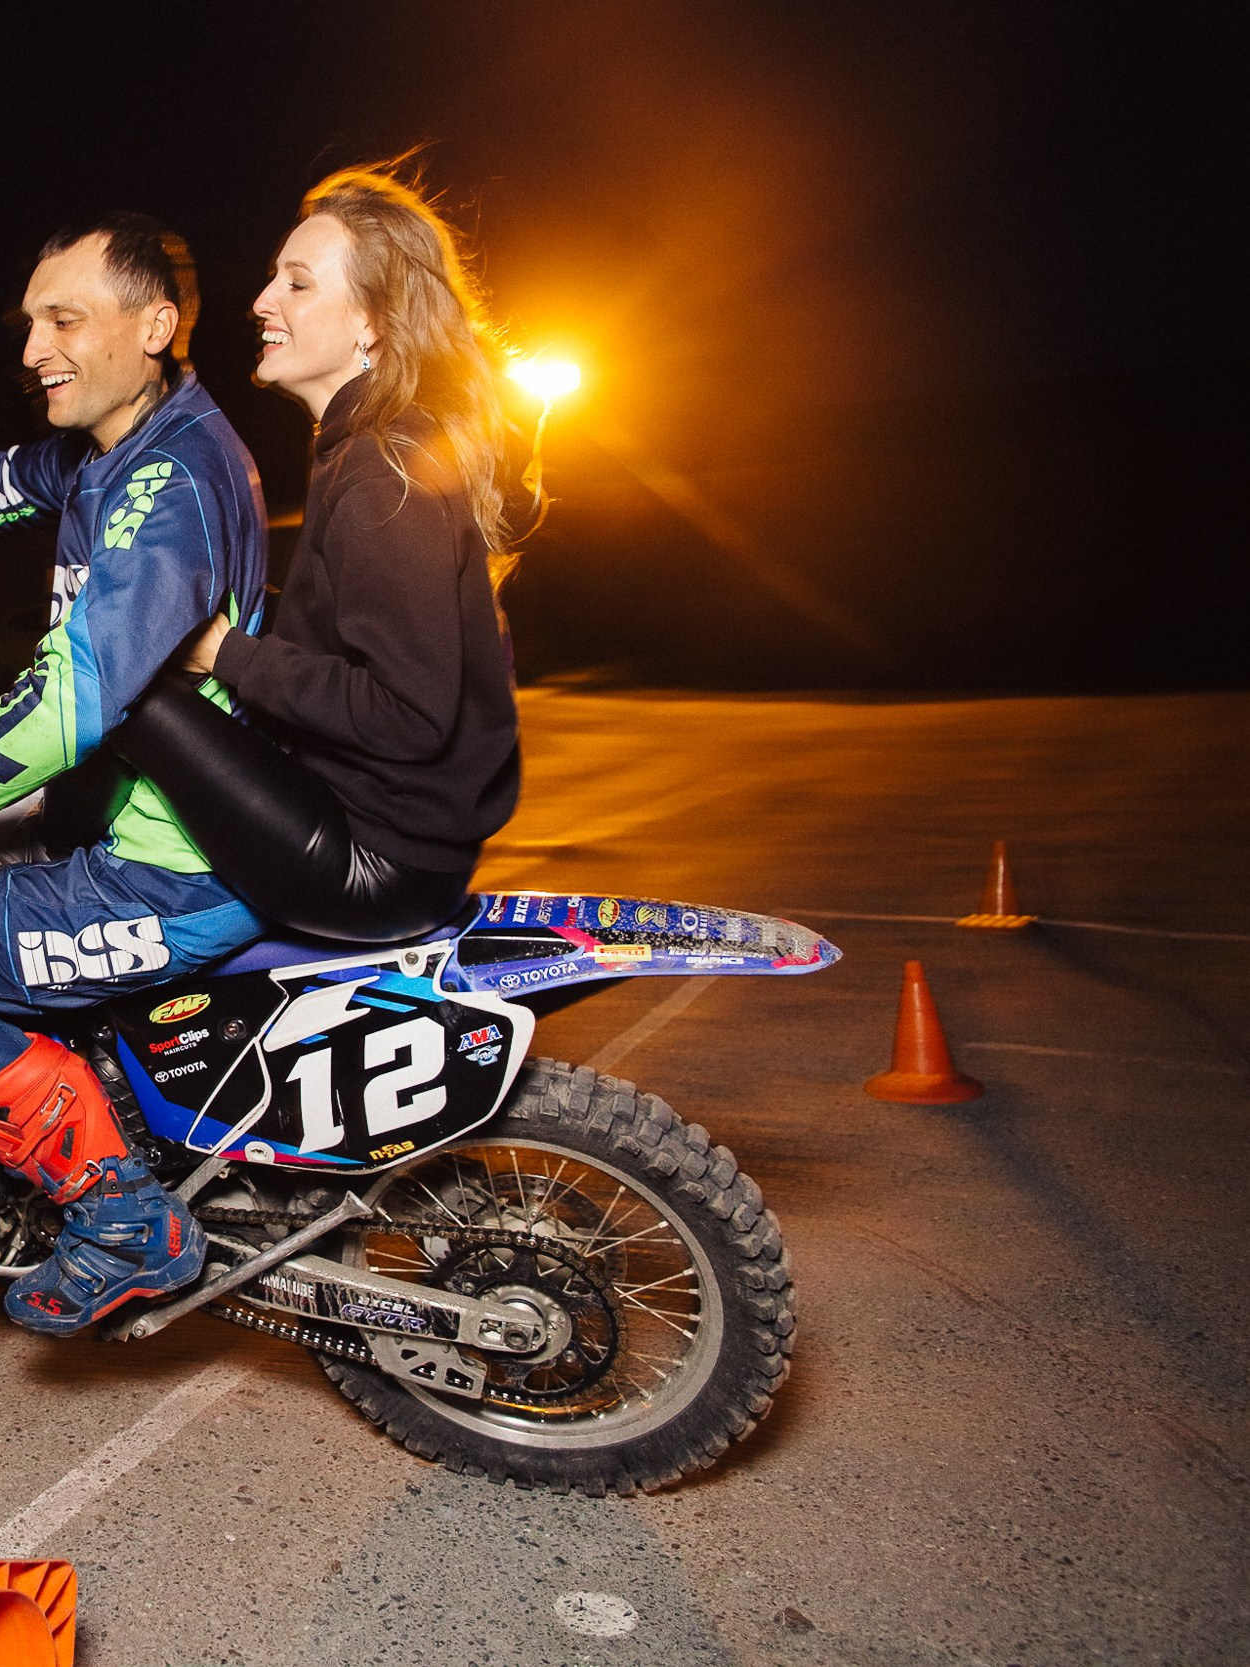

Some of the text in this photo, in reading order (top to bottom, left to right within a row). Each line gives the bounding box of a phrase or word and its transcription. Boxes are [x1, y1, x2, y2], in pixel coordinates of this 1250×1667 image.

[521, 962, 579, 982] TOYOTA
[150, 994, 210, 1023] FMF
[149, 1029, 210, 1054] SportClips
[164, 1042, 198, 1056] HAIRCUTS
[457, 1024, 503, 1052] AMA
[168, 1061, 208, 1079] TOYOTA
[285, 1016, 447, 1154] 12
[168, 1210, 182, 1258] LEATT
[27, 1291, 62, 1316] 5.5
